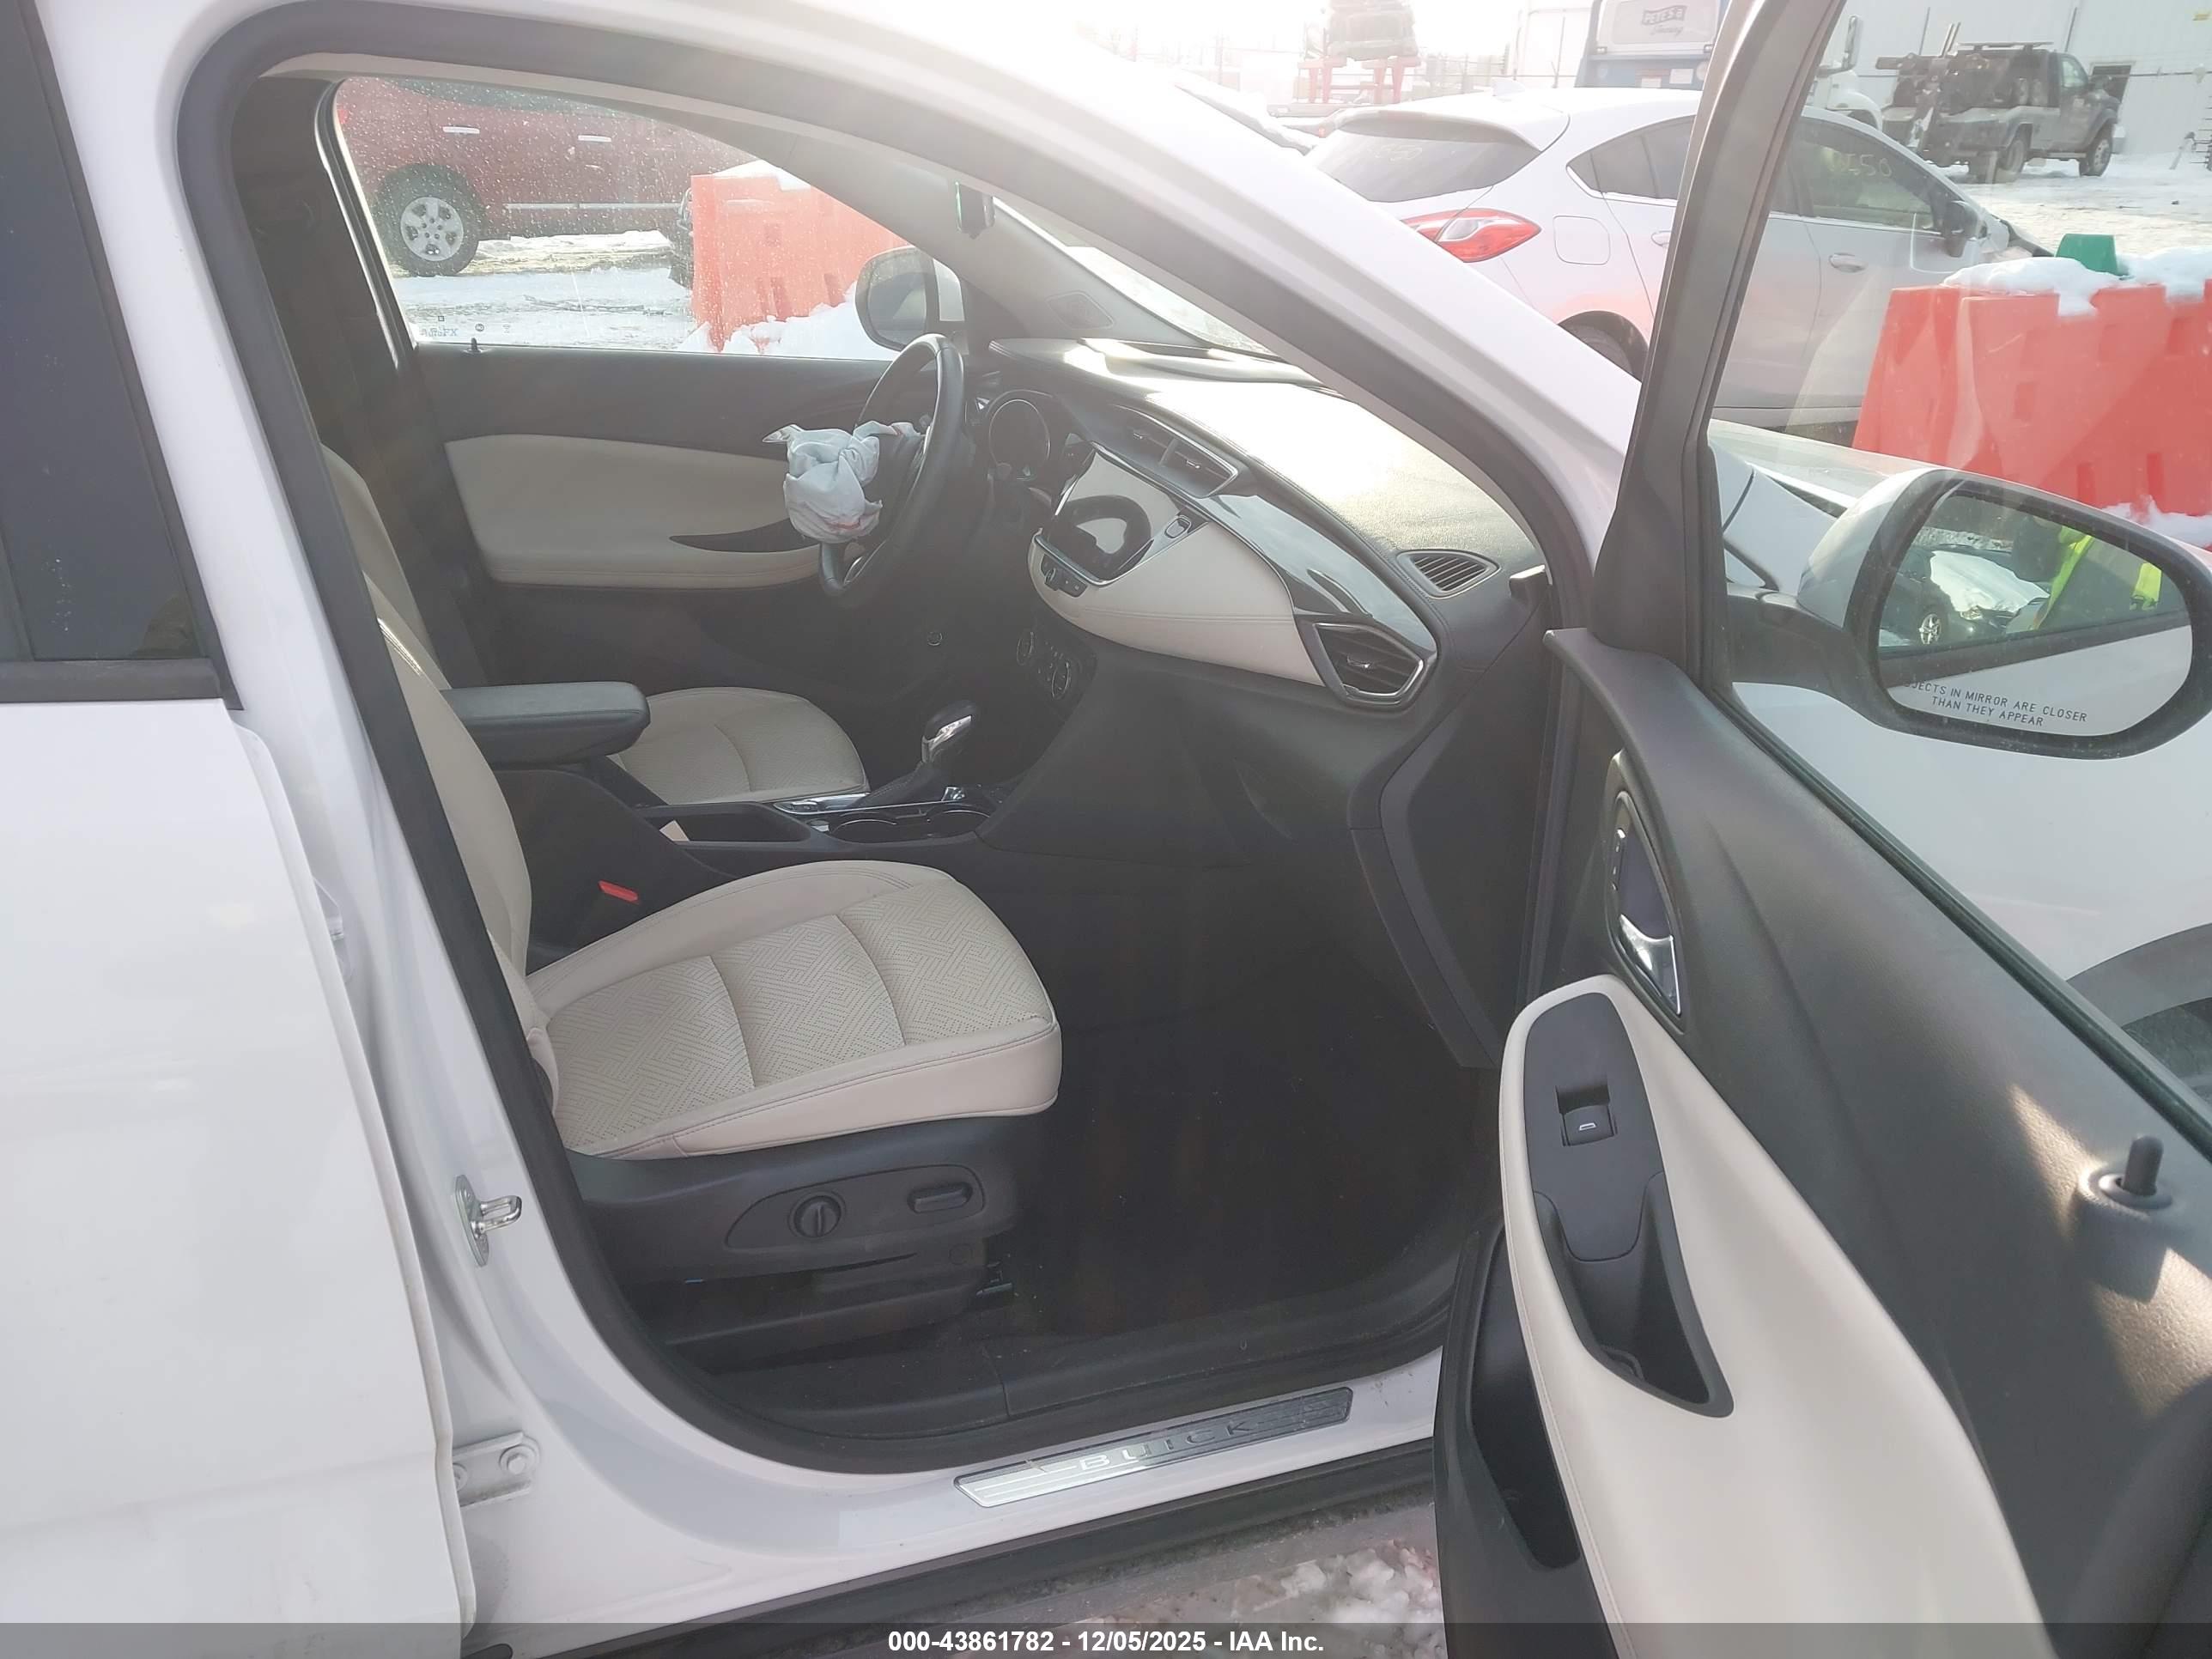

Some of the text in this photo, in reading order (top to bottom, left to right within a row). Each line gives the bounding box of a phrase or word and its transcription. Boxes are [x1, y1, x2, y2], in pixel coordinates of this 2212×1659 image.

[1905, 682, 2087, 722] JECTS IN MIRROR ARE CLOSER
[1932, 696, 2044, 726] THAN THEY APPEAR
[1079, 1421, 1249, 1471] BUICK
